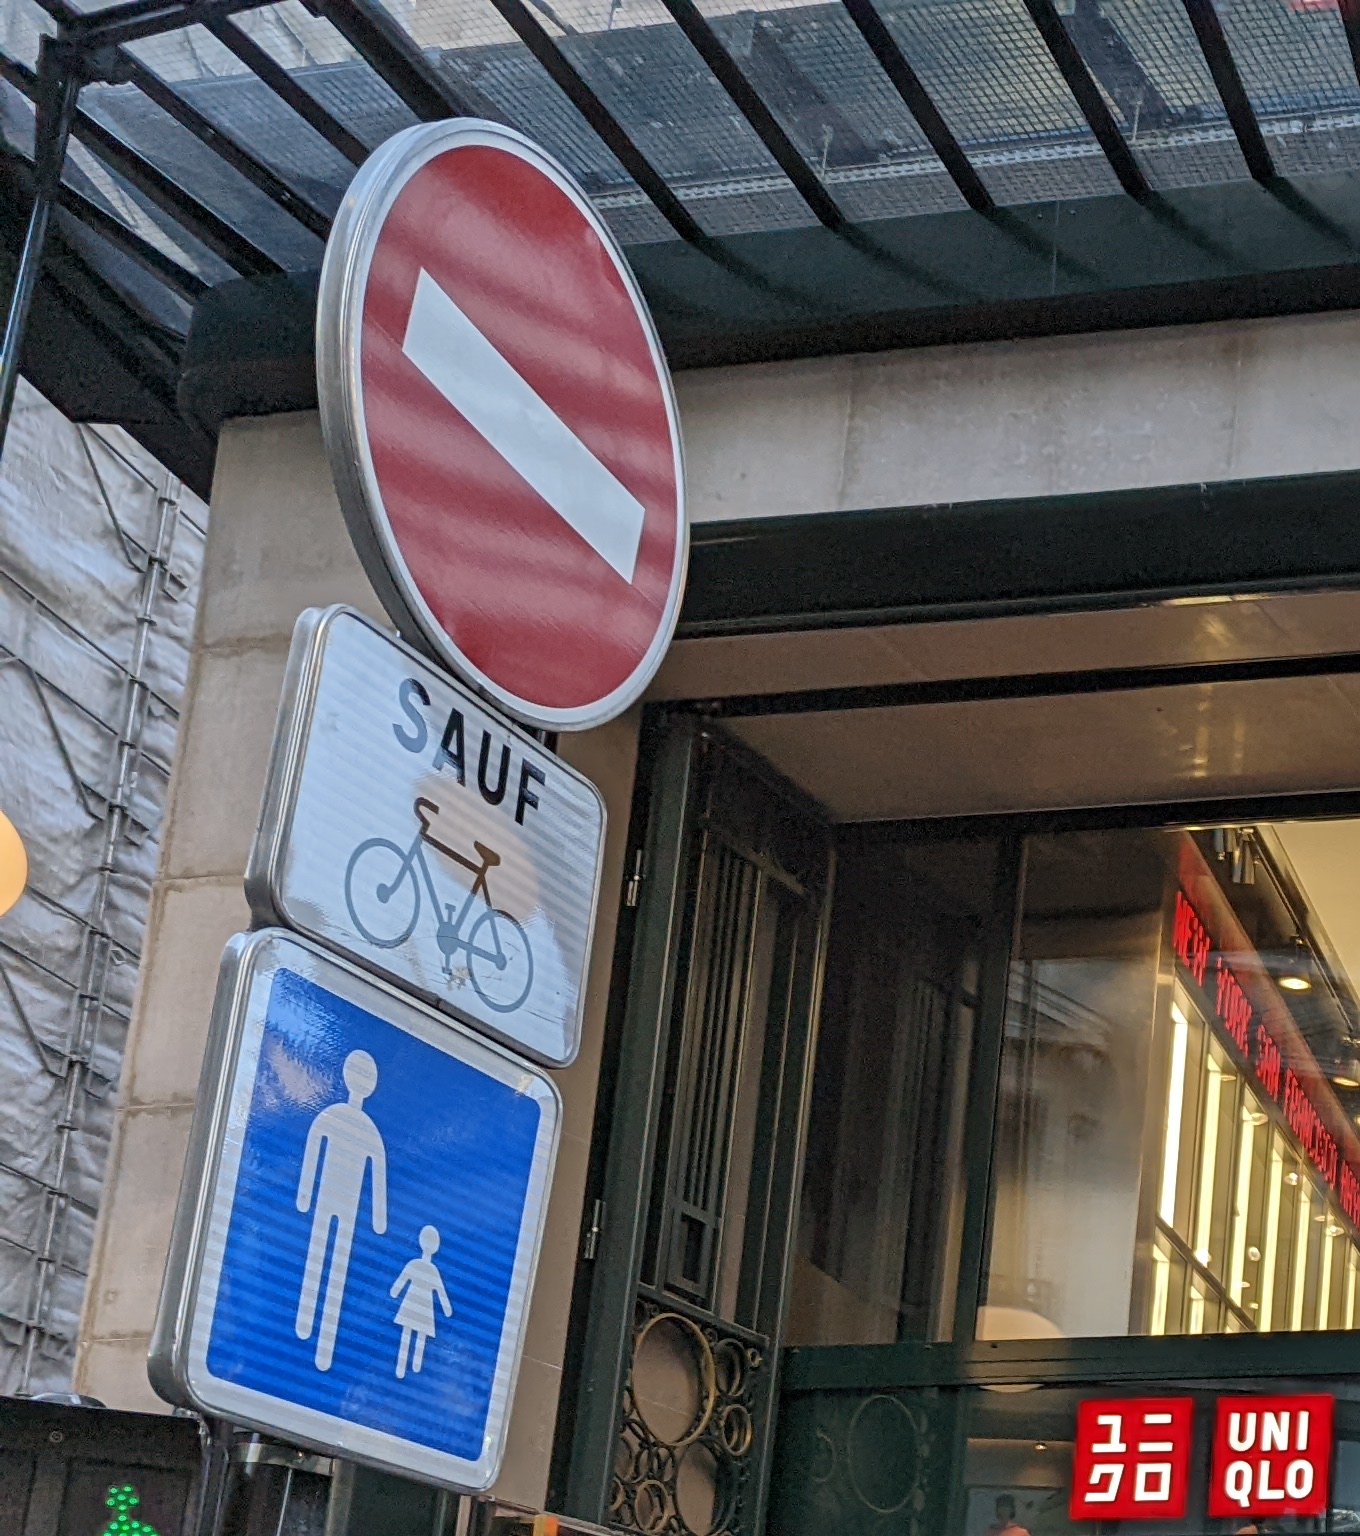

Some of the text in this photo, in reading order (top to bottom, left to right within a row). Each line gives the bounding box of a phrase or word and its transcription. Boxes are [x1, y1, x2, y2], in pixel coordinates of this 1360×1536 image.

[392, 677, 546, 826] SAUF
[1173, 891, 1211, 987] NEW
[1092, 1413, 1173, 1453] ユニ
[1228, 1411, 1310, 1452] UNI
[1084, 1462, 1172, 1503] クロ
[1224, 1459, 1314, 1508] QLO
